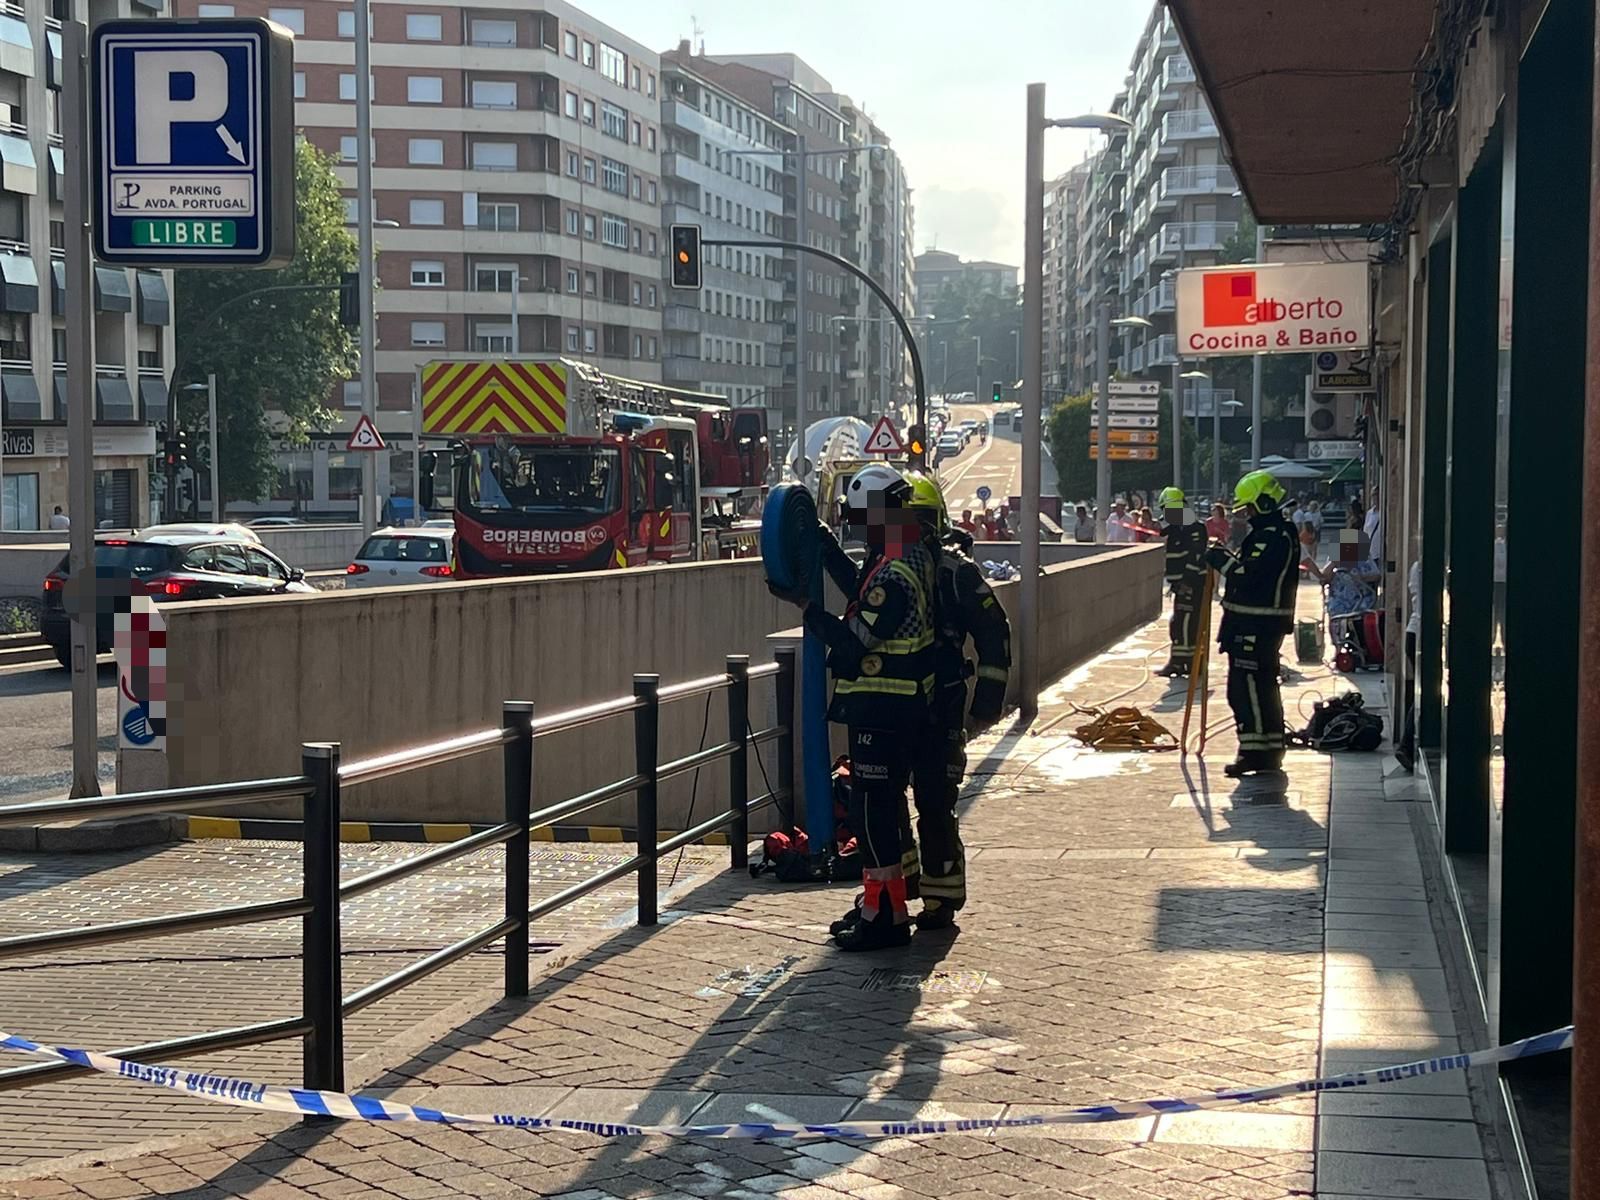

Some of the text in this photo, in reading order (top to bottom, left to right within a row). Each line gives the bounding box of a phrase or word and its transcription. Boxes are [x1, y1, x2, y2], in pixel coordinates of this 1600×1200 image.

[134, 50, 229, 164] P
[169, 185, 222, 196] PARKING
[144, 199, 247, 209] AVDA. PORTUGAL
[150, 222, 223, 243] LIBRE
[1244, 297, 1343, 323] alberto
[1189, 327, 1357, 350] Cocina & Baño
[2, 431, 33, 454] Rivas
[857, 733, 873, 745] 142
